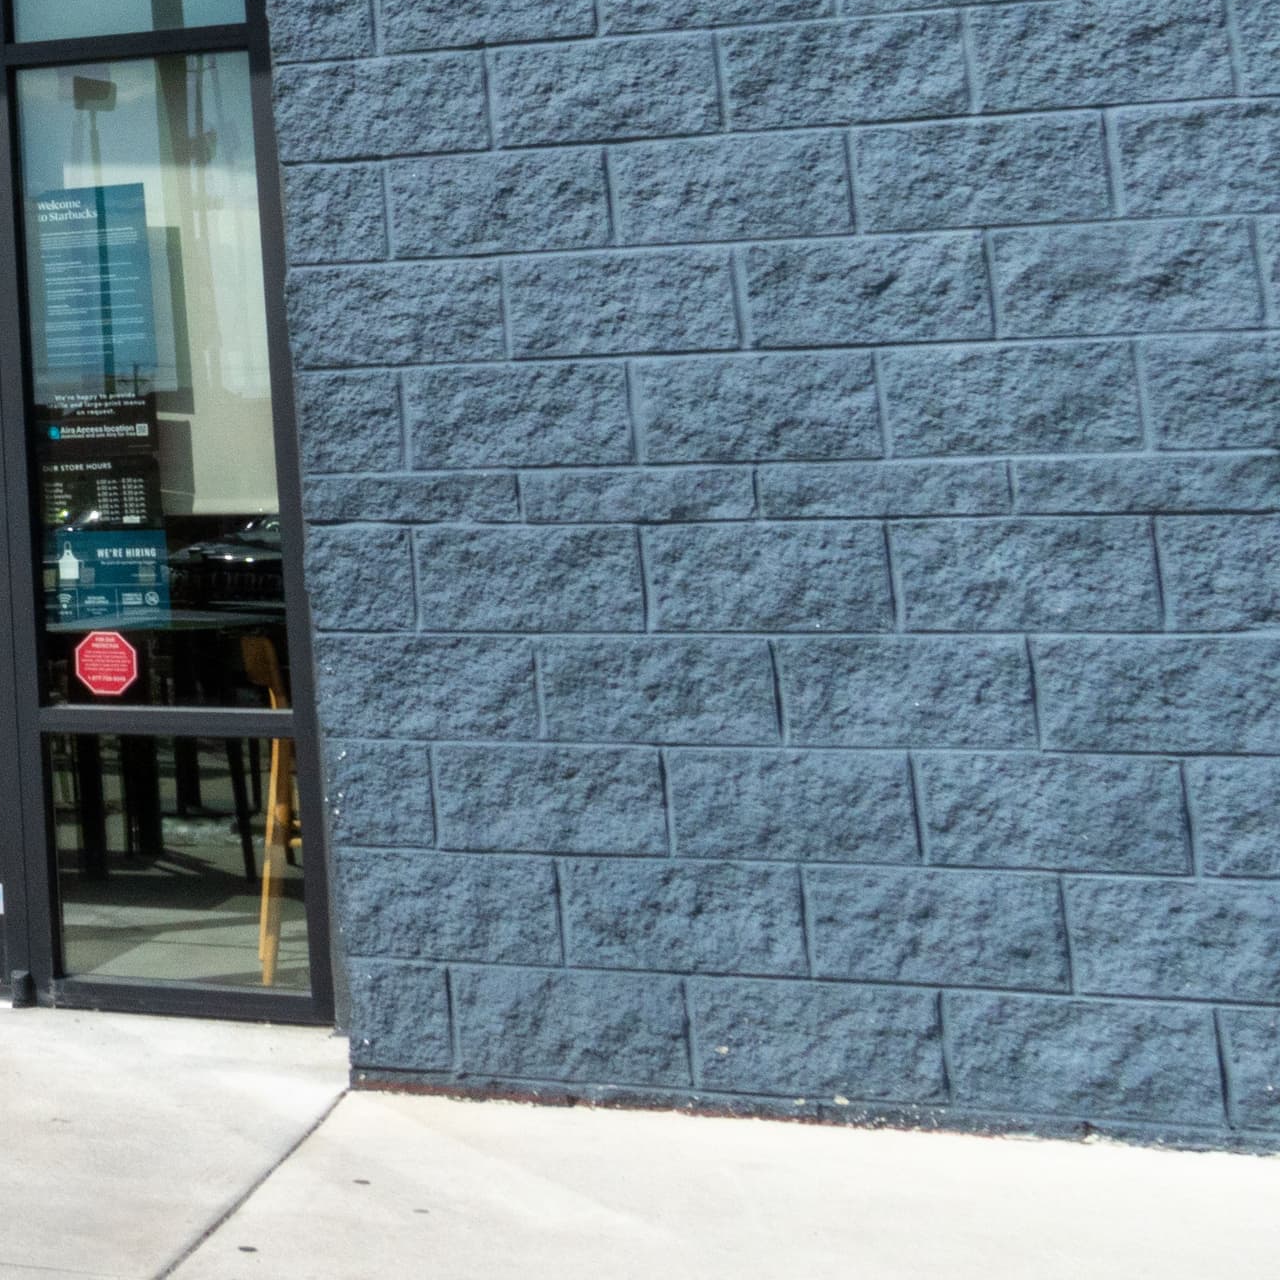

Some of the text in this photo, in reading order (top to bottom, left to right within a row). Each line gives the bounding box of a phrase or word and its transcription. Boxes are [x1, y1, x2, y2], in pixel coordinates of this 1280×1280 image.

[37, 199, 81, 213] Welcome
[49, 210, 97, 223] Starbucks
[98, 547, 157, 558] WE'RE HIRING
